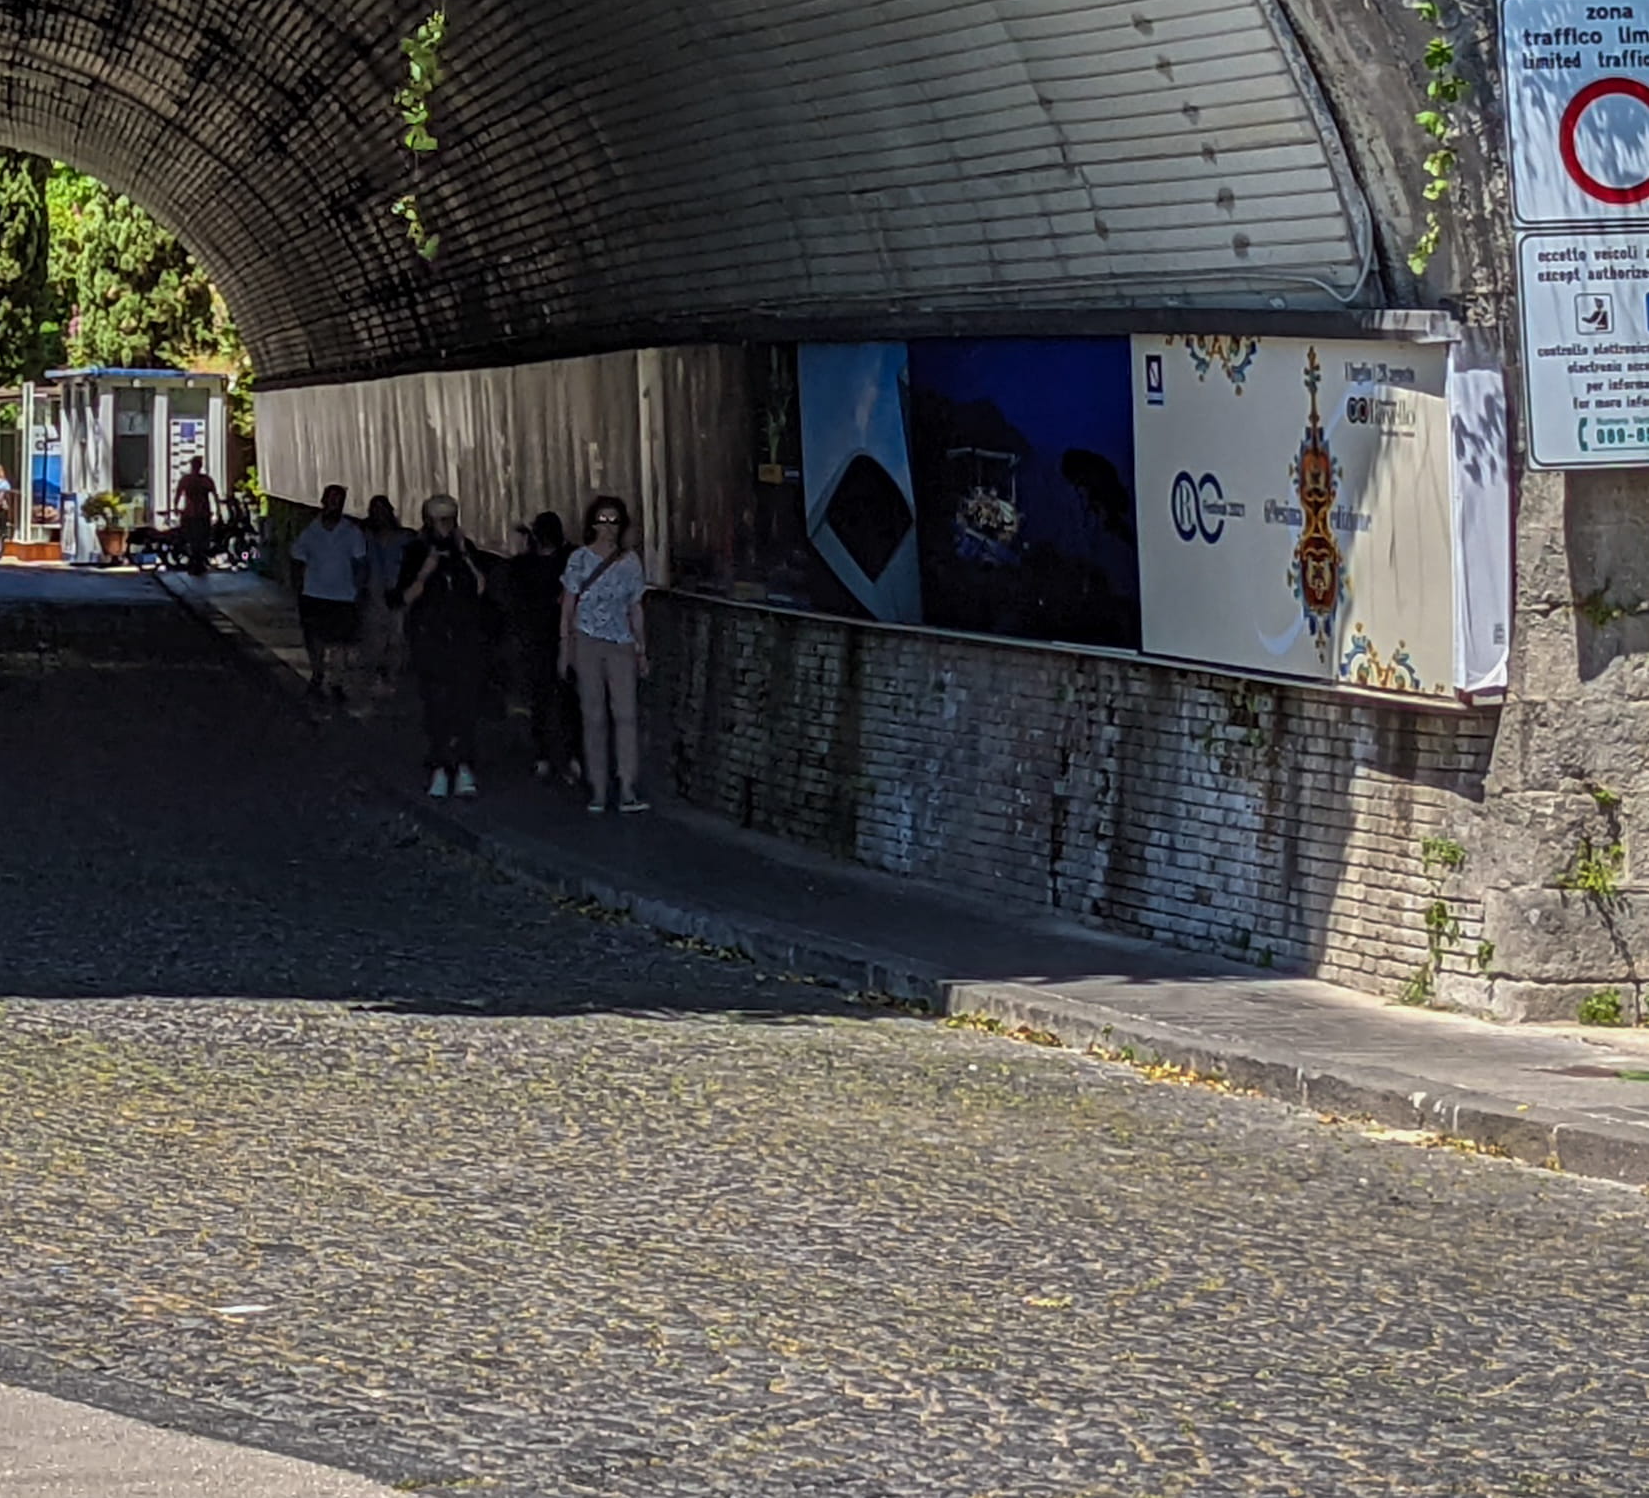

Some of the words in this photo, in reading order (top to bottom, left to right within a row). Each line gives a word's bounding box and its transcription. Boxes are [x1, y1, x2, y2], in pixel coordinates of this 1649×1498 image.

[1585, 6, 1634, 20] zona
[1523, 27, 1603, 46] traffico
[1522, 50, 1582, 70] limited
[1537, 246, 1587, 263] eccetto
[1594, 245, 1638, 261] veicoli
[1537, 267, 1581, 285] except
[1586, 382, 1604, 394] per
